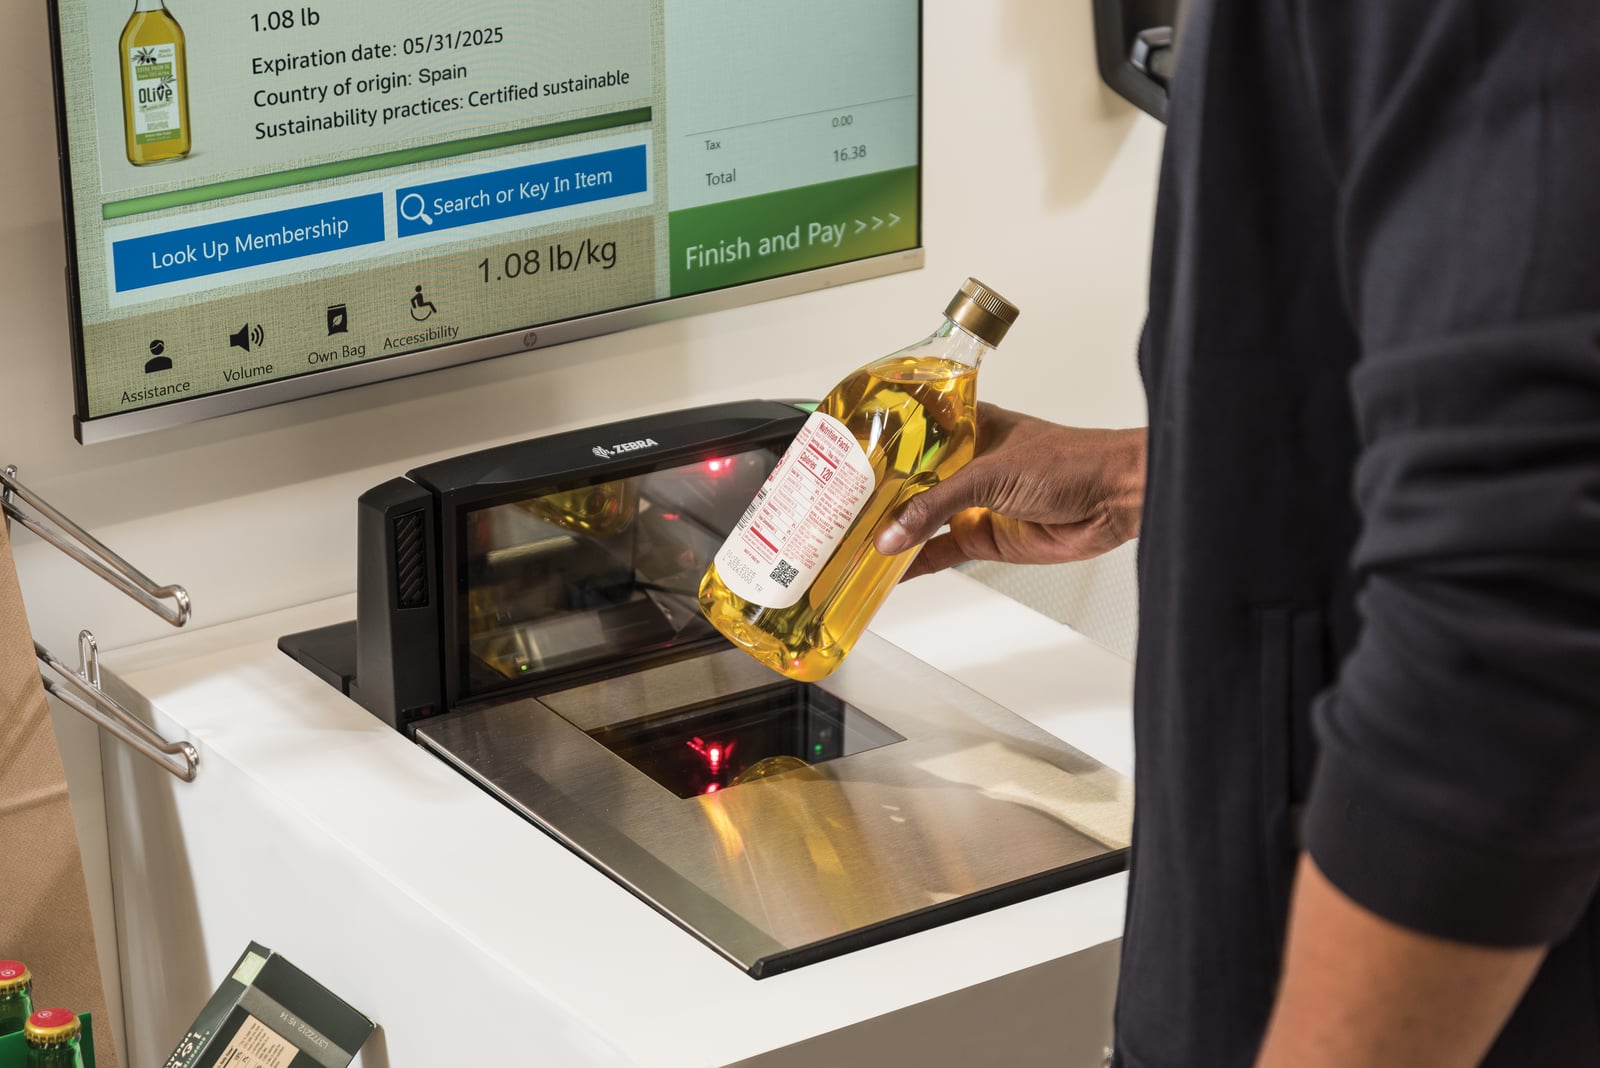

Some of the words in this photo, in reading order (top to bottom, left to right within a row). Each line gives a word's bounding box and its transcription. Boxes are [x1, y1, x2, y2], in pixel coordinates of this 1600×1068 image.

[250, 9, 295, 32] 1.08
[301, 7, 320, 27] lb
[252, 49, 346, 76] Expiration
[351, 44, 397, 62] date:
[403, 27, 504, 55] 05/31/2025
[254, 85, 328, 107] Country
[333, 77, 352, 97] of
[356, 72, 412, 94] origin:
[418, 64, 467, 86] Spain
[255, 108, 378, 140] Sustainability
[383, 95, 464, 125] practices:
[468, 82, 538, 107] Certified
[543, 69, 630, 97] sustainable
[831, 114, 853, 128] 0.00
[704, 139, 721, 151] Tax
[833, 144, 867, 163] 16.38
[705, 168, 737, 187] Total
[433, 189, 490, 216] Search
[496, 187, 515, 204] or
[519, 181, 550, 201] Key
[554, 175, 570, 193] In
[575, 170, 613, 190] Item
[151, 244, 198, 270] Look
[202, 240, 230, 262] Up
[234, 216, 350, 254] Membership
[686, 236, 750, 270] Finish
[758, 225, 800, 256] and
[808, 222, 847, 247] Pay
[478, 249, 540, 283] 1.08
[549, 238, 617, 272] lb/kg
[383, 324, 460, 351] Accessibility
[307, 350, 338, 366] Own
[342, 344, 367, 359] Bag
[222, 363, 273, 383] Volume
[120, 379, 191, 405] Assistance
[612, 438, 659, 454] ZEBRA
[820, 466, 833, 482] 120
